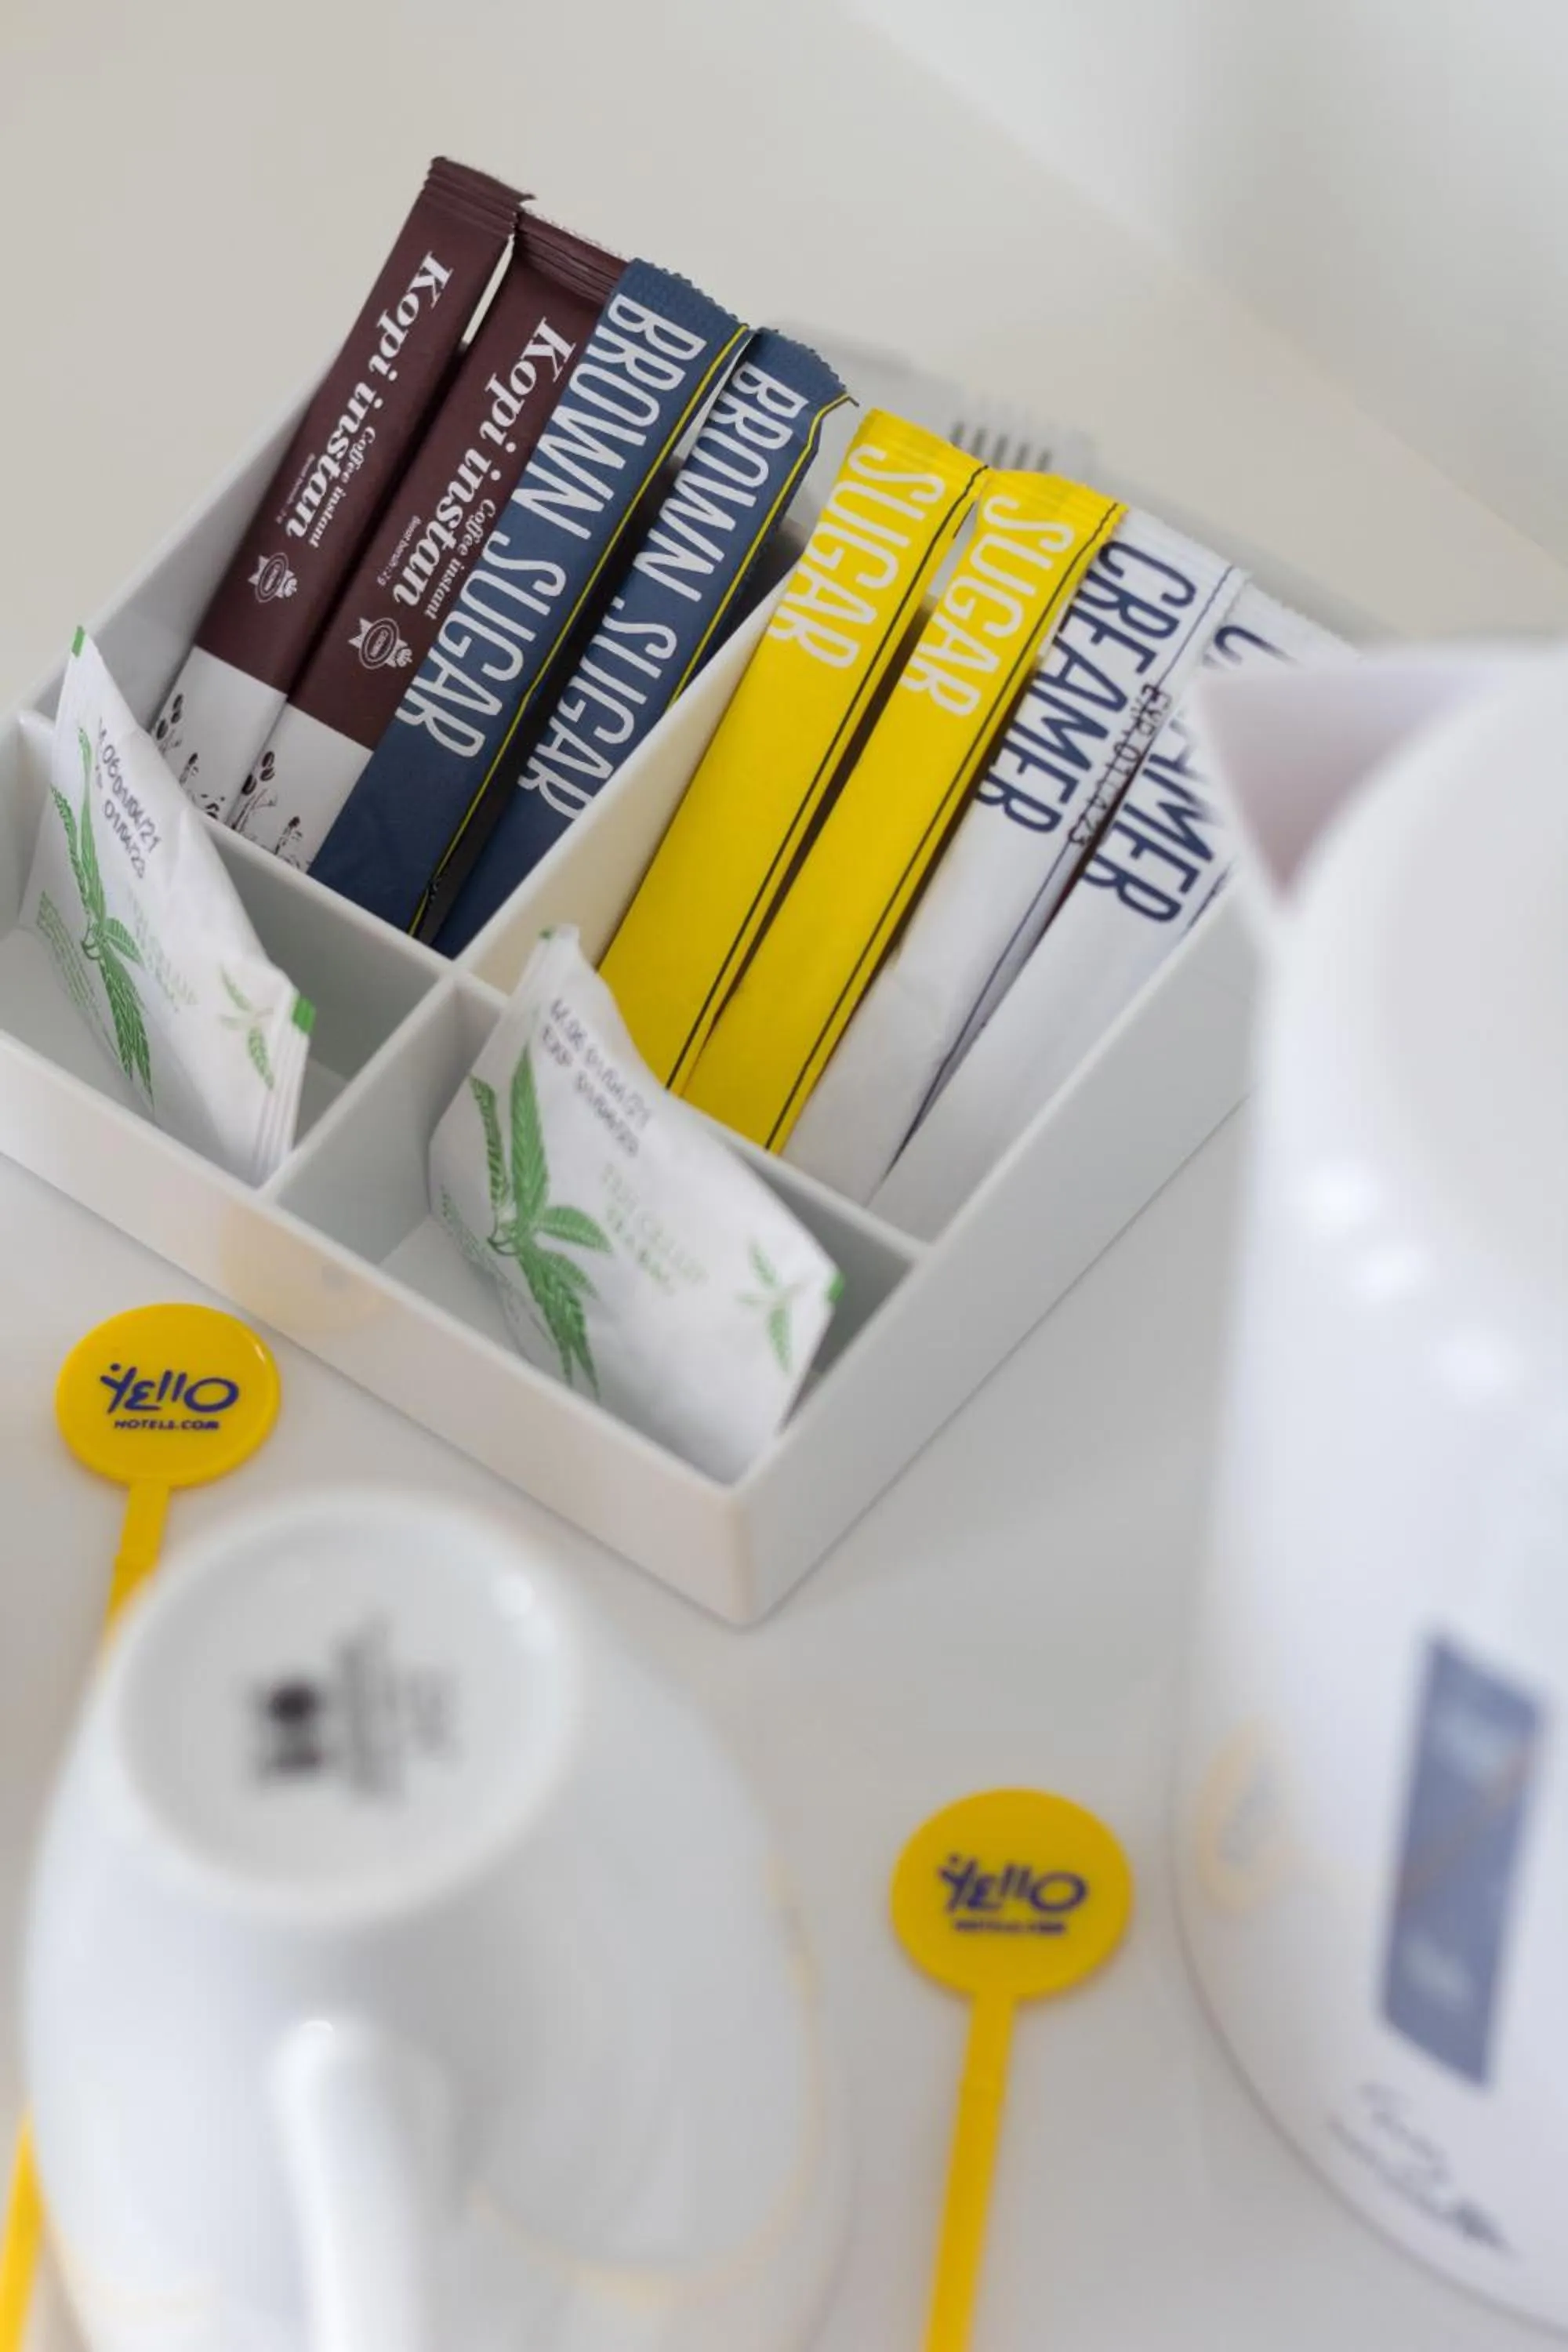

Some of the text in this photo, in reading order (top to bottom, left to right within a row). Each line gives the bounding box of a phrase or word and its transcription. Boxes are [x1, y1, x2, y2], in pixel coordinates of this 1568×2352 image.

[368, 251, 454, 381] Kopi
[285, 382, 384, 538] instan
[308, 426, 376, 548] Coffee instant
[393, 316, 576, 607] Kopi instan
[394, 293, 707, 758] BROWN SUGAR
[424, 499, 496, 620] Coffee instant
[767, 443, 946, 670] SUGAR
[517, 362, 809, 821] BROWN SUGAR
[898, 494, 1075, 717] SUGAR
[974, 539, 1197, 834] CREAMER
